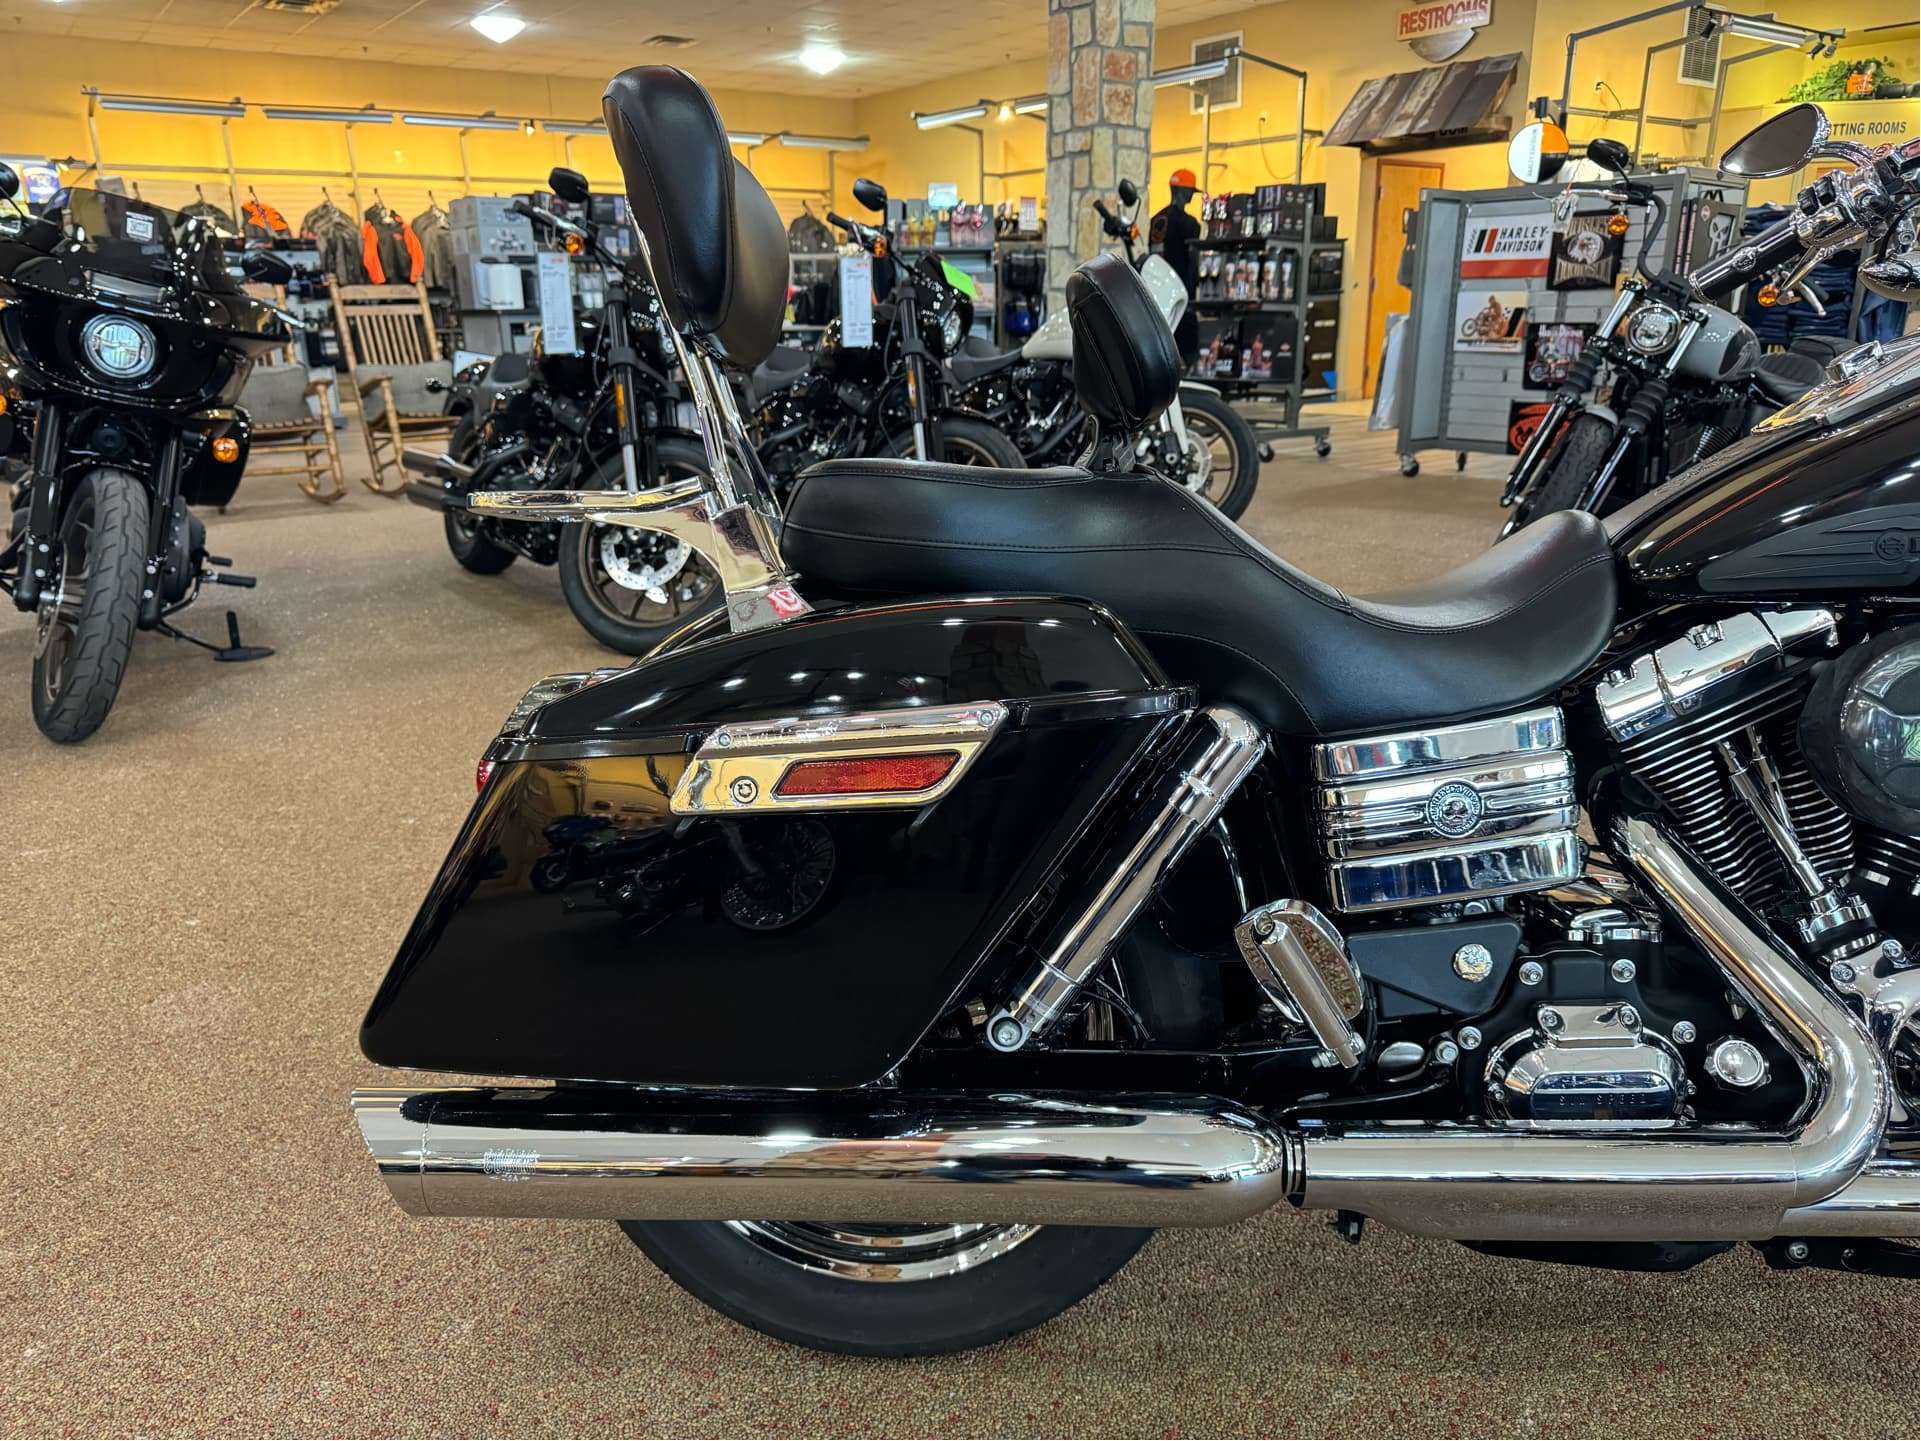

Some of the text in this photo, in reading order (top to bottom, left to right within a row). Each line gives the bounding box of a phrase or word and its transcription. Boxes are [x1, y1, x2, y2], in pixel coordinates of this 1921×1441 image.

[1833, 121, 1907, 136] TTING ROOMS
[1499, 225, 1549, 239] HARLEY-
[1494, 240, 1544, 253] DAVIDSON
